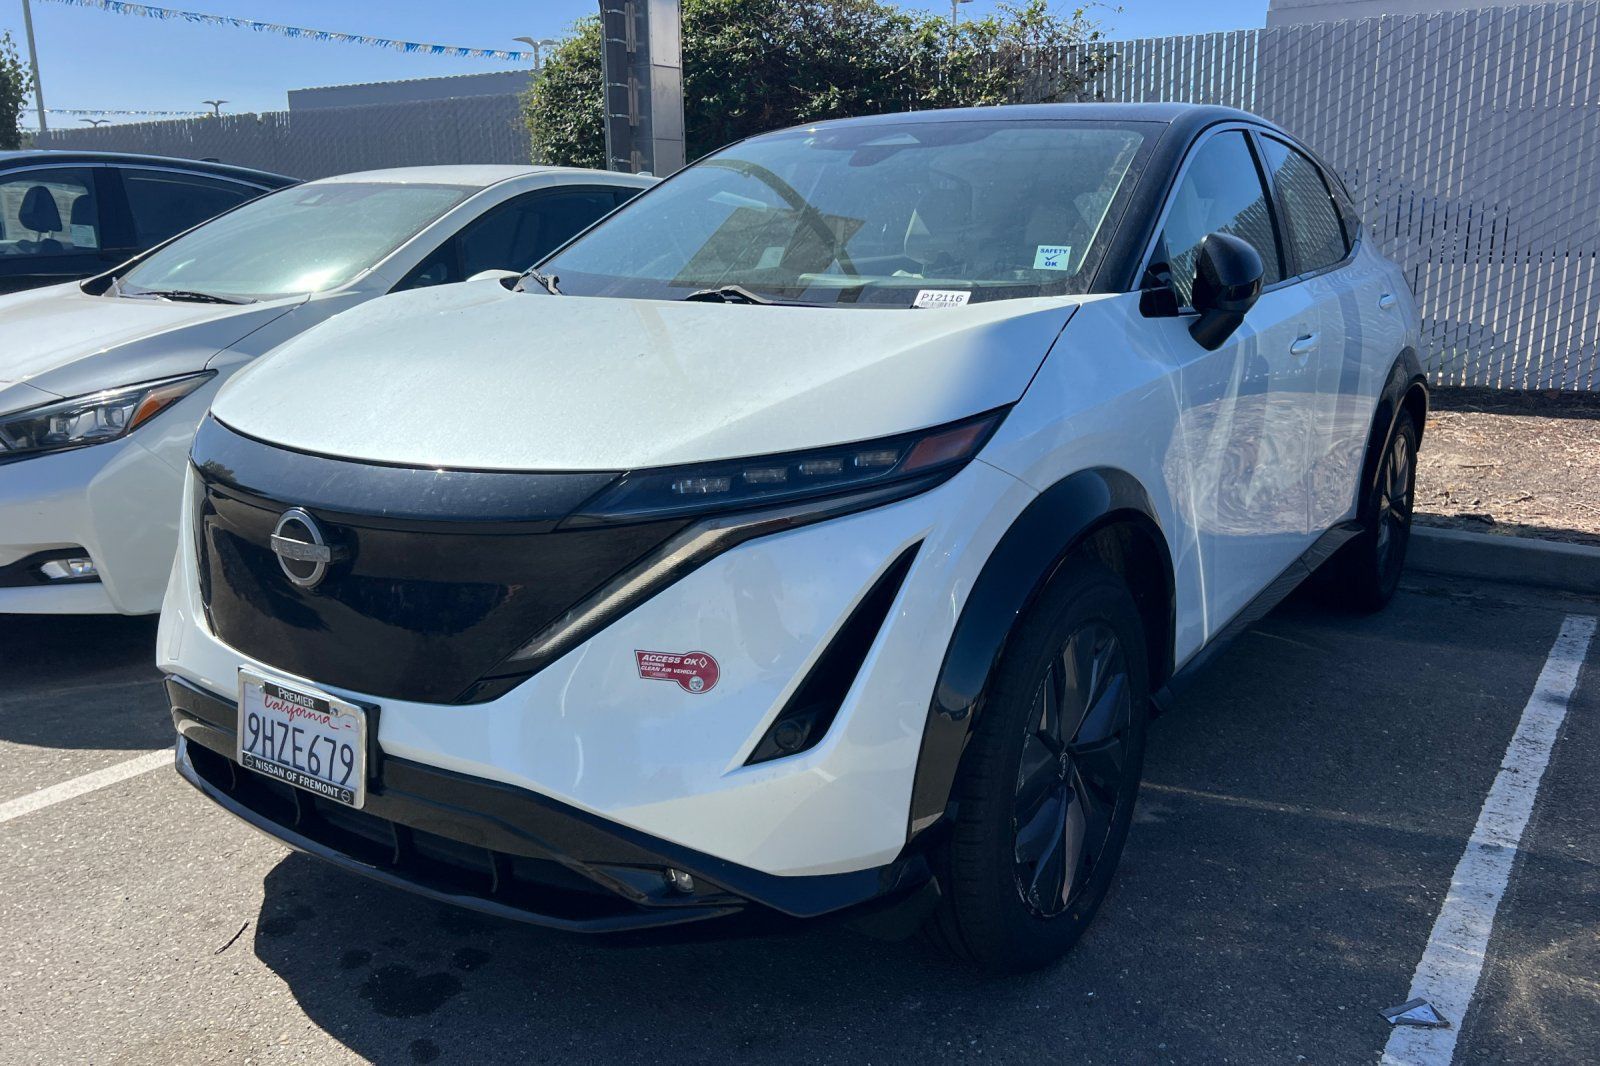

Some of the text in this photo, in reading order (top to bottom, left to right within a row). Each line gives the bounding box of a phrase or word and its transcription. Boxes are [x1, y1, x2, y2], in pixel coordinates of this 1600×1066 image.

[921, 293, 964, 303] P12116
[641, 654, 698, 666] ACCESS OK
[278, 687, 314, 708] PREMIER
[248, 712, 354, 786] 9HZE679
[255, 760, 340, 798] NISSAN OF FREMONT
